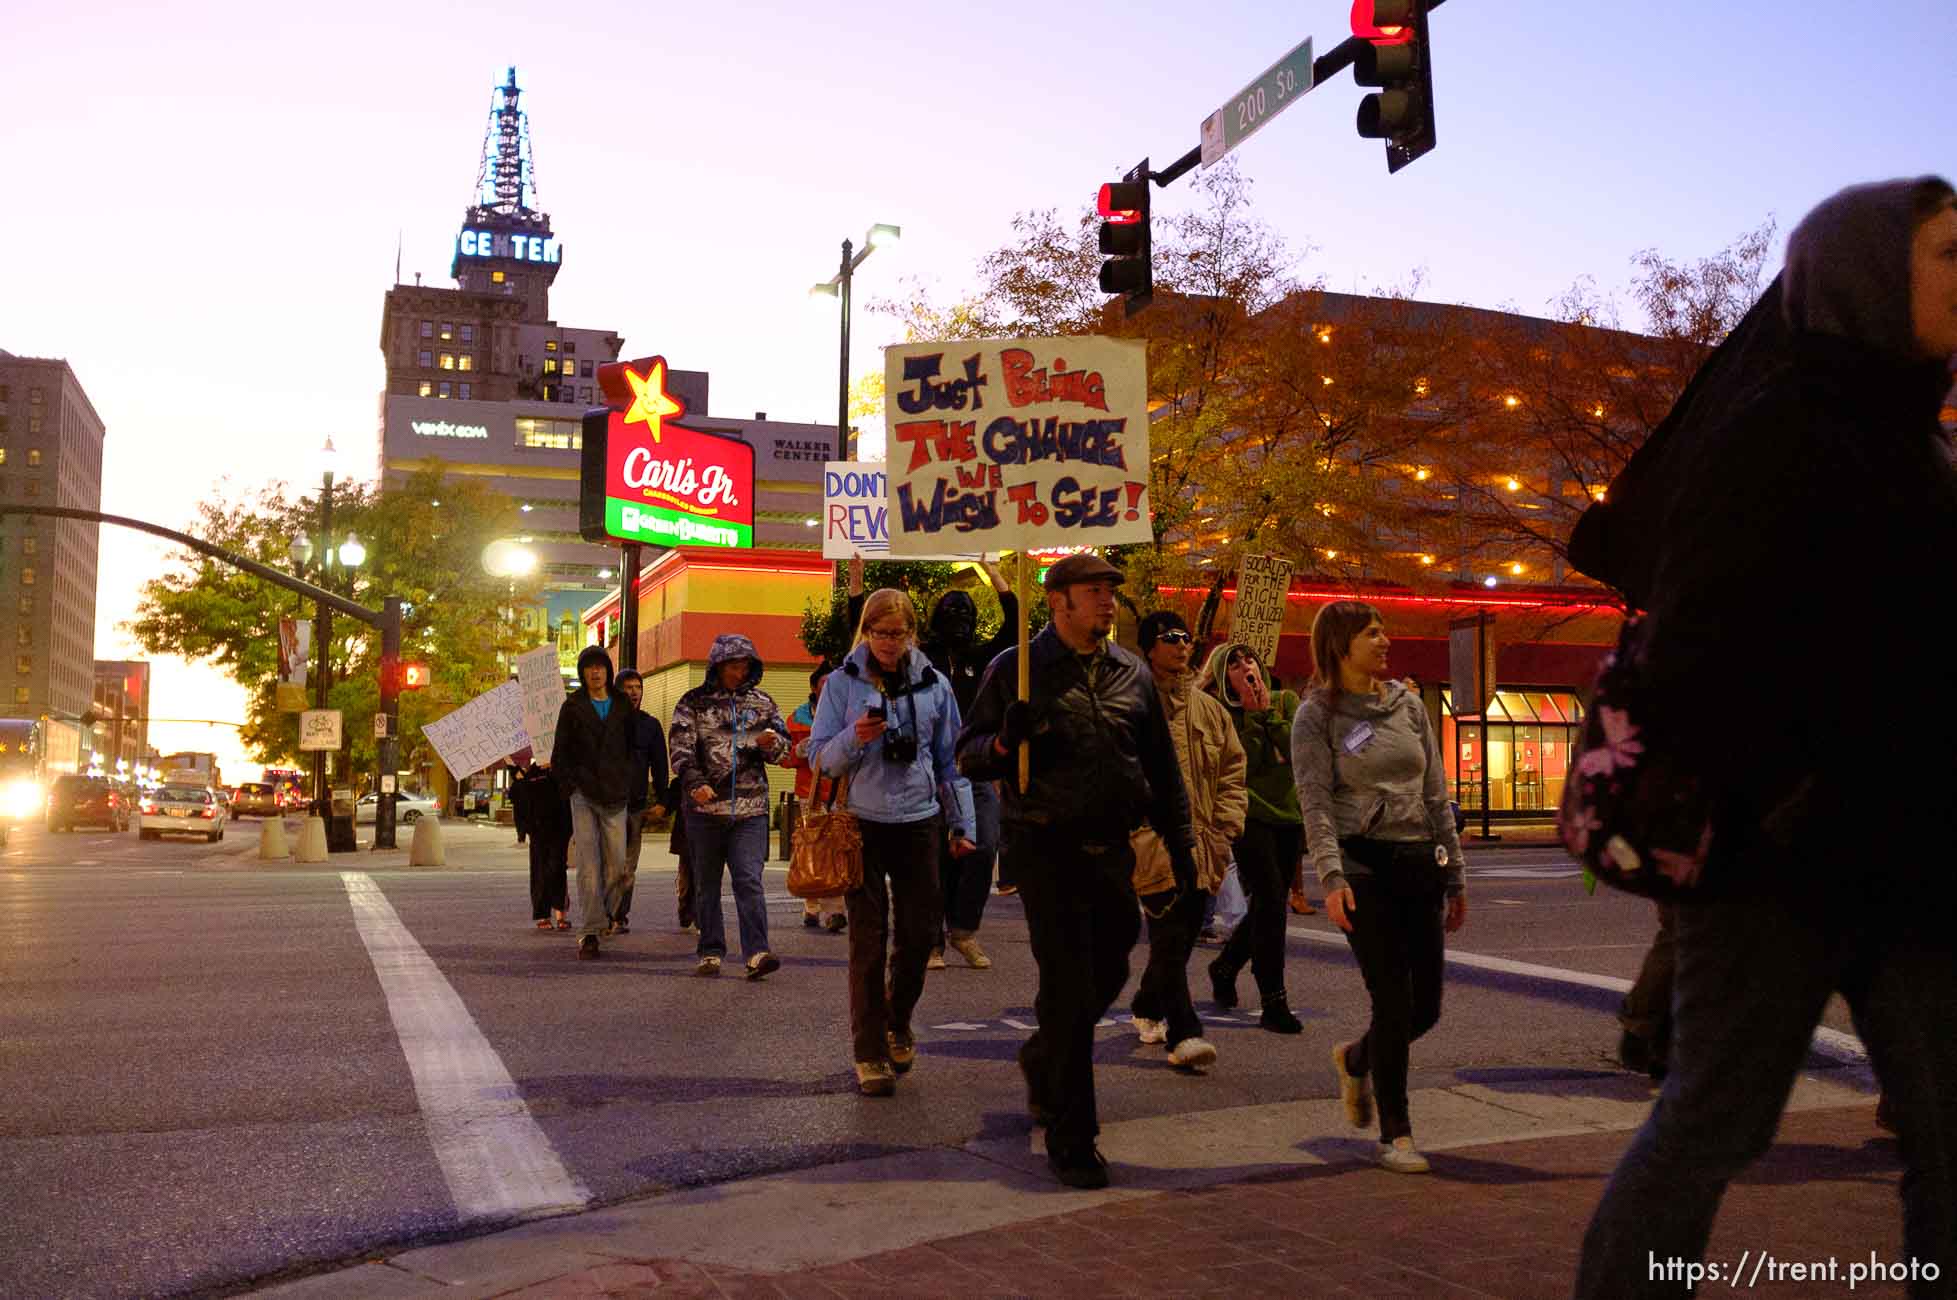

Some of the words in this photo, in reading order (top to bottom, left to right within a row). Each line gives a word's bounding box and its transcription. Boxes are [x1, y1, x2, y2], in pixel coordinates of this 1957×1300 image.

[1238, 87, 1265, 130] 200
[774, 440, 831, 451] WALKER
[894, 419, 977, 474] THE
[982, 416, 1128, 472] CHANGE
[774, 451, 830, 461] CENTER
[623, 447, 698, 495] Carl's
[697, 465, 738, 506] Jr.
[955, 463, 1003, 488] WE
[1243, 574, 1260, 587] FOR
[1262, 575, 1286, 590] THE
[1245, 586, 1279, 605] RICH
[1240, 620, 1273, 635] DEBT
